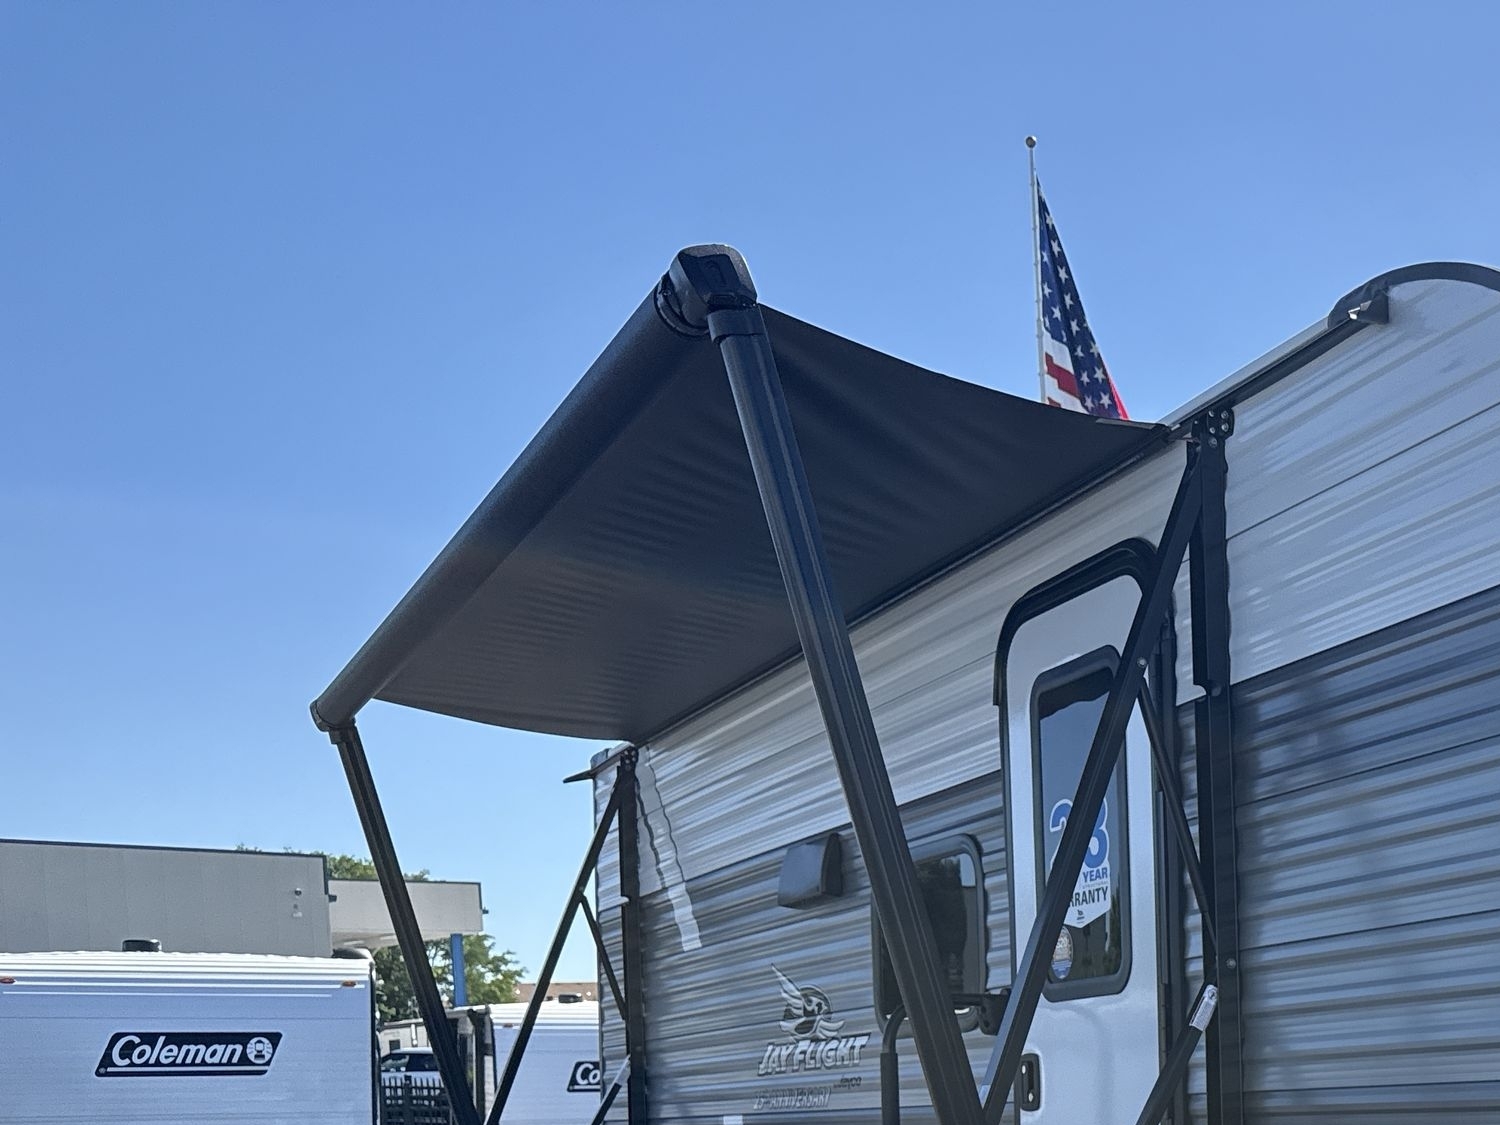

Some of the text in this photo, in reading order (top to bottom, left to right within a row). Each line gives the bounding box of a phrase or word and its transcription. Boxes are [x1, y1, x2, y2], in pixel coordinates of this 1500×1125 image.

[1082, 867, 1108, 883] YEAR
[1071, 886, 1108, 907] RANTY
[112, 1035, 243, 1066] Coleman
[757, 1033, 870, 1076] JAY FLIGHT
